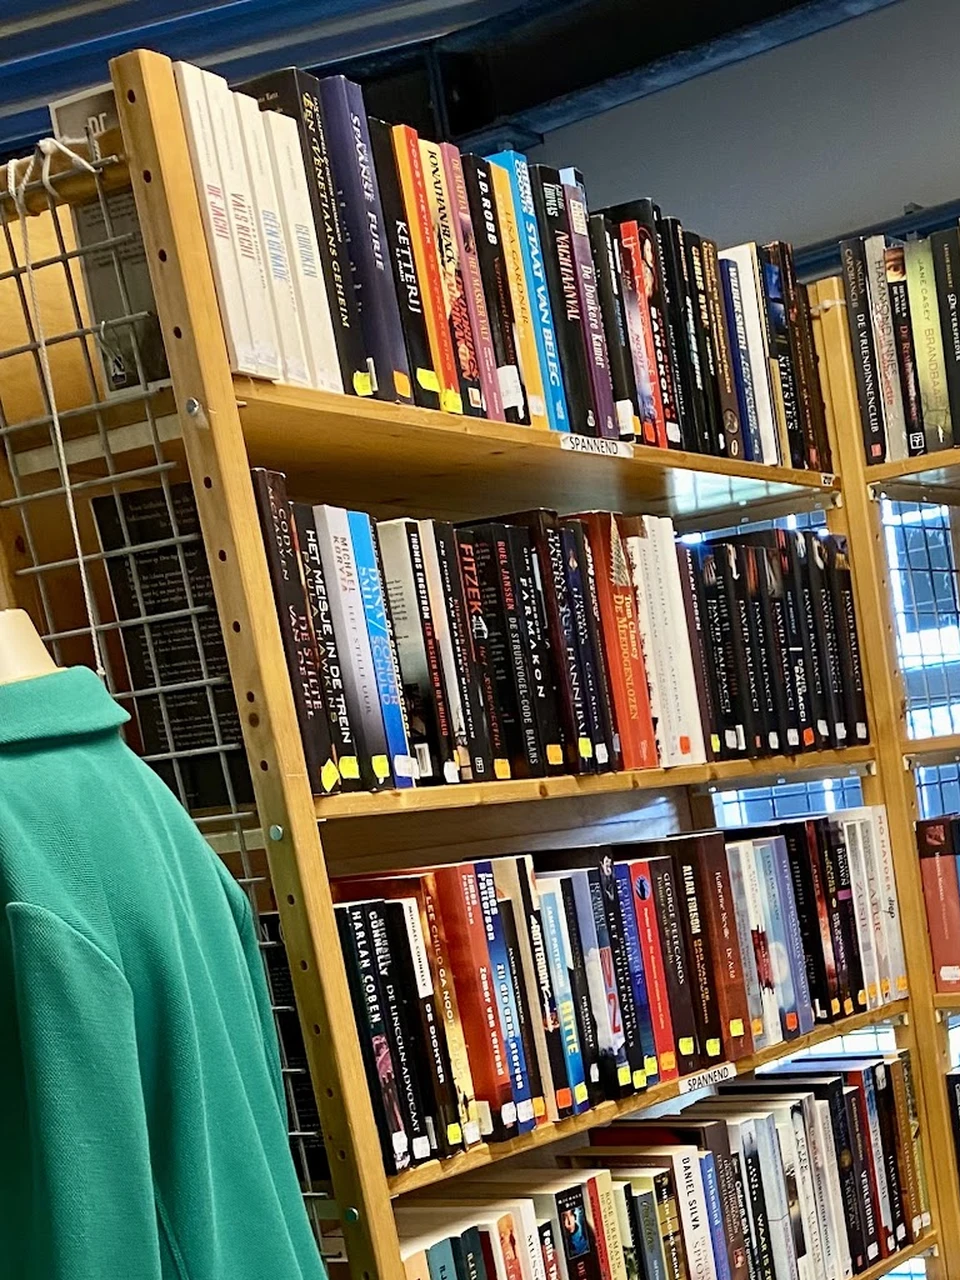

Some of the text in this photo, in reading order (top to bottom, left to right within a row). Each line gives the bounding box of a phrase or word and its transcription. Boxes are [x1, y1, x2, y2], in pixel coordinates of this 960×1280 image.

[482, 194, 497, 246] ROBB
[396, 220, 421, 313] KETTERIJ
[570, 436, 618, 455] SPANNEND
[305, 529, 320, 565] HET
[312, 569, 332, 636] MEISJE
[460, 542, 482, 614] FITZEK
[335, 694, 351, 744] TREIN
[351, 910, 382, 1023] HARLAN COBEN
[688, 1067, 729, 1092] SPANNEND
[682, 1157, 700, 1231] DANIEL SILVA
